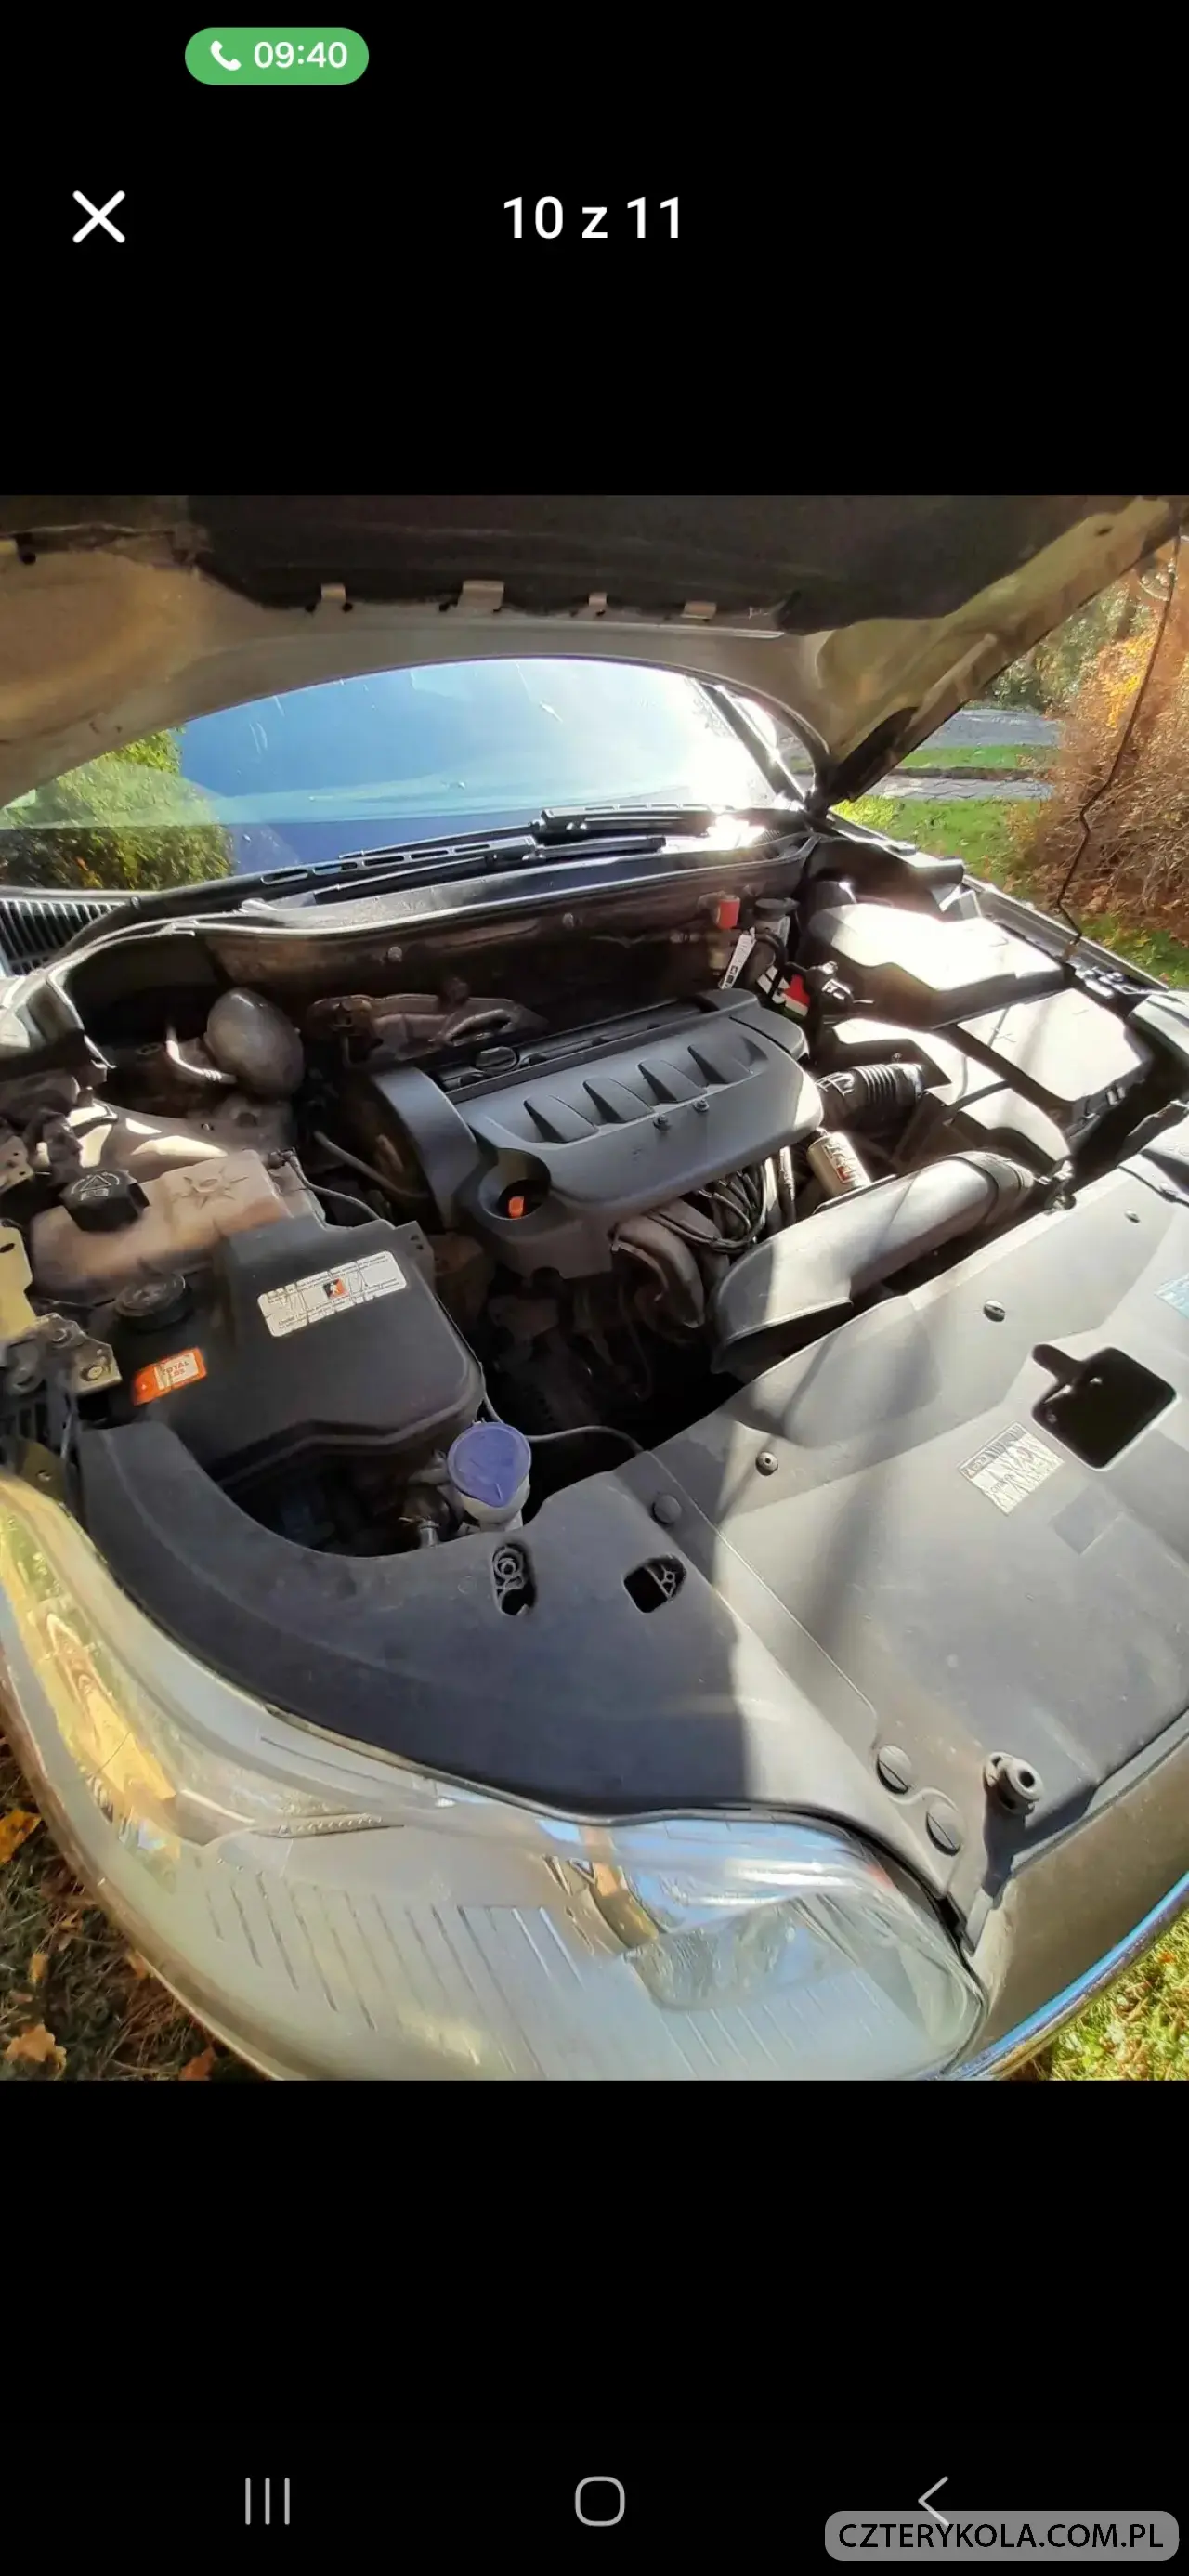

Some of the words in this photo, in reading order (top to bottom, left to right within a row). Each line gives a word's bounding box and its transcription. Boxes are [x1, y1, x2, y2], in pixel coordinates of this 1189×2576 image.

[255, 42, 346, 68] 09:40
[504, 196, 563, 239] 10
[582, 207, 608, 238] z
[627, 196, 681, 239] 11
